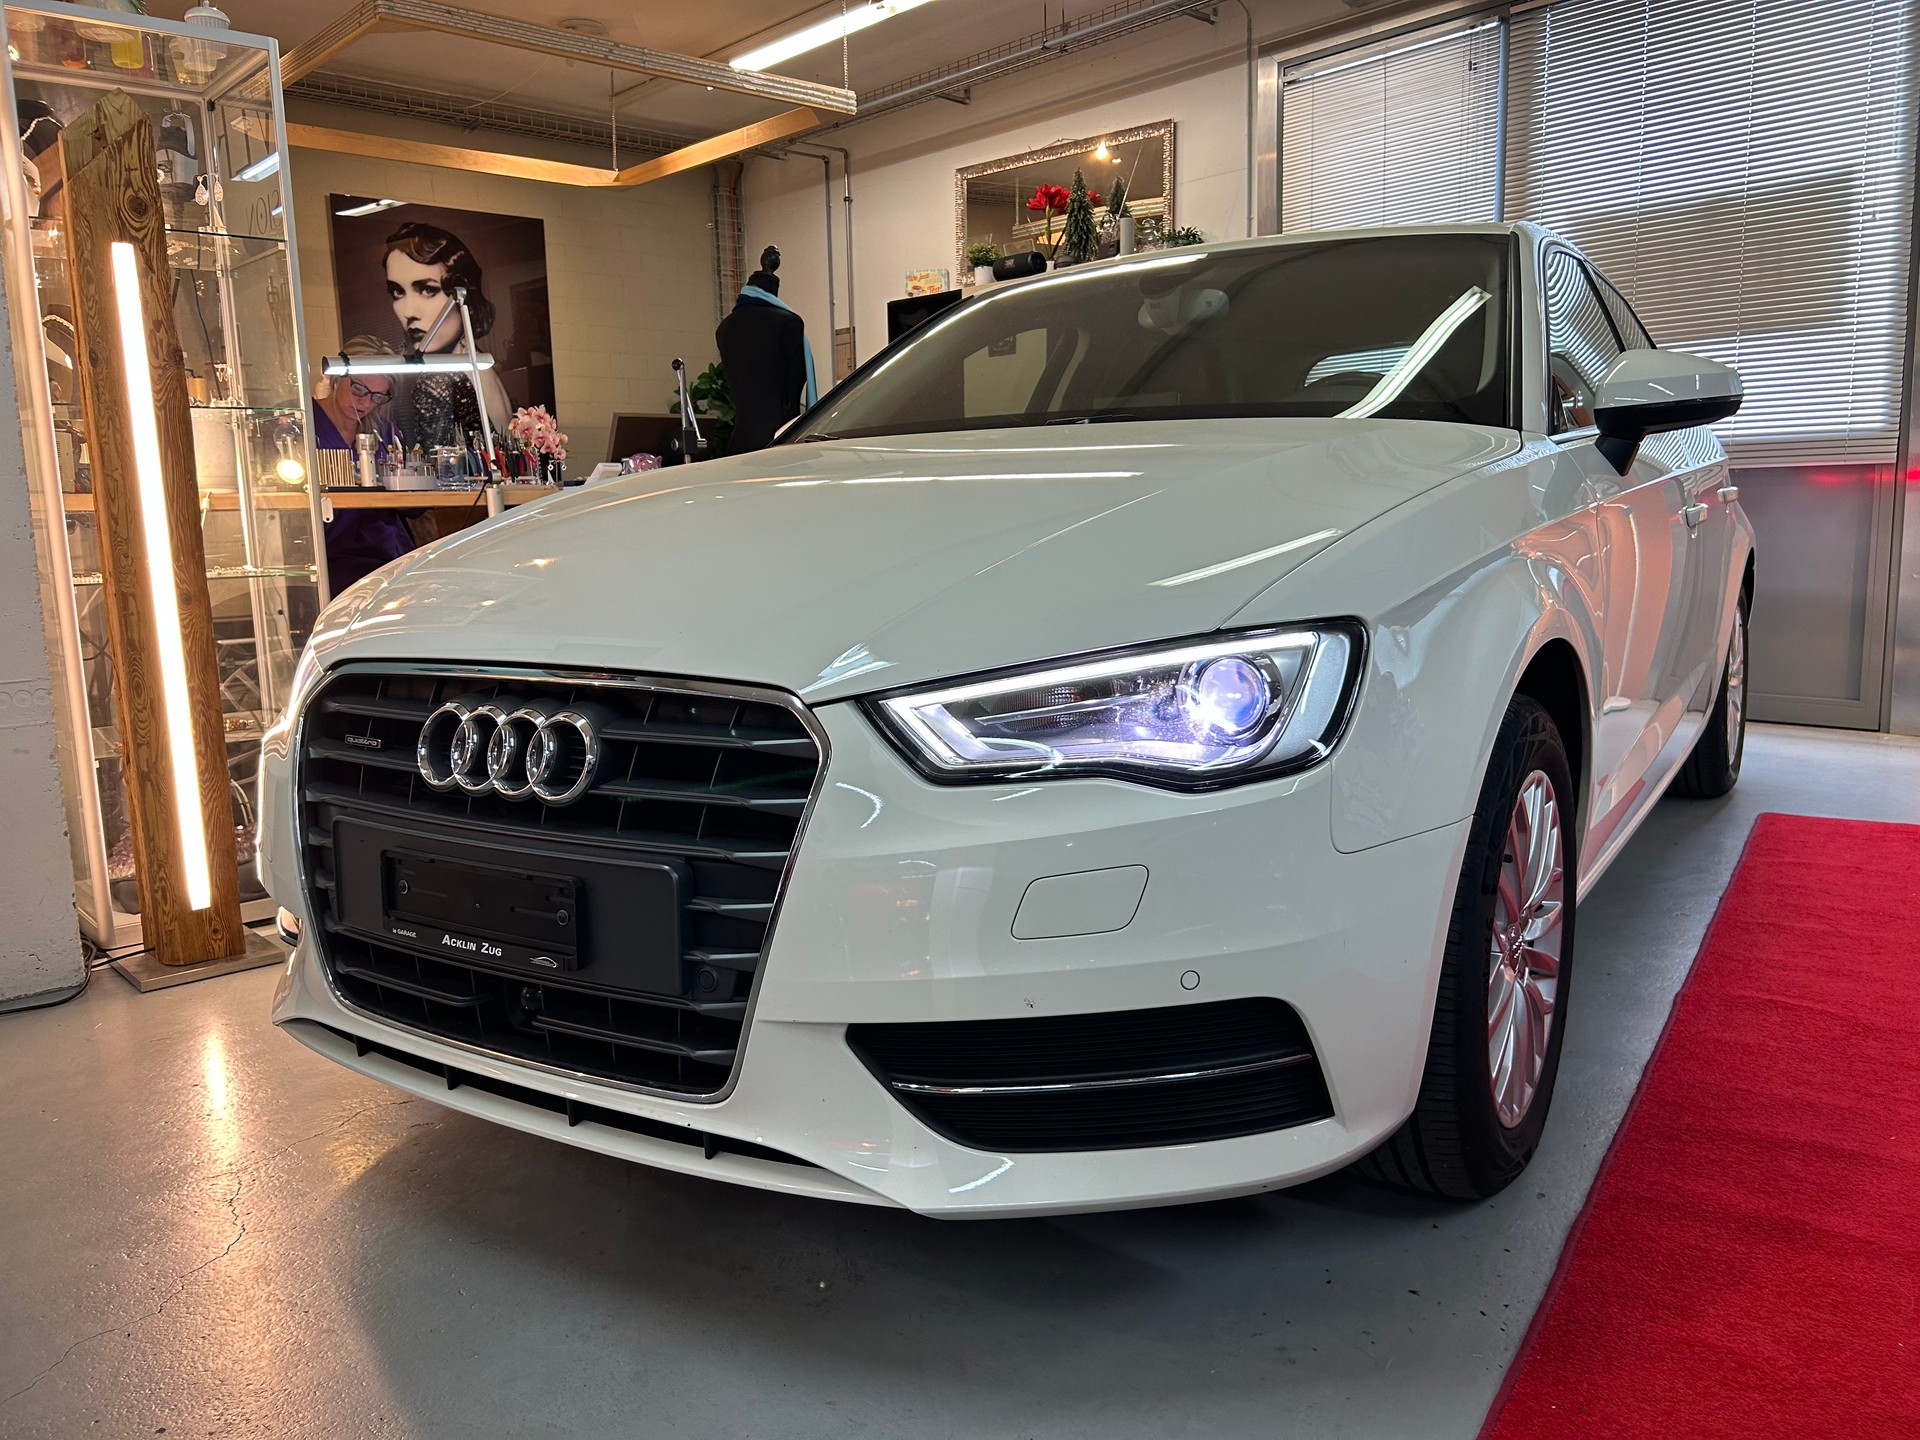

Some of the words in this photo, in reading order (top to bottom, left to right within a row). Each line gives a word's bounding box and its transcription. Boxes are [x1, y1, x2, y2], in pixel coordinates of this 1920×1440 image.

[347, 736, 377, 746] quattro
[441, 934, 477, 951] ACKLIN
[480, 942, 502, 957] ZUG
